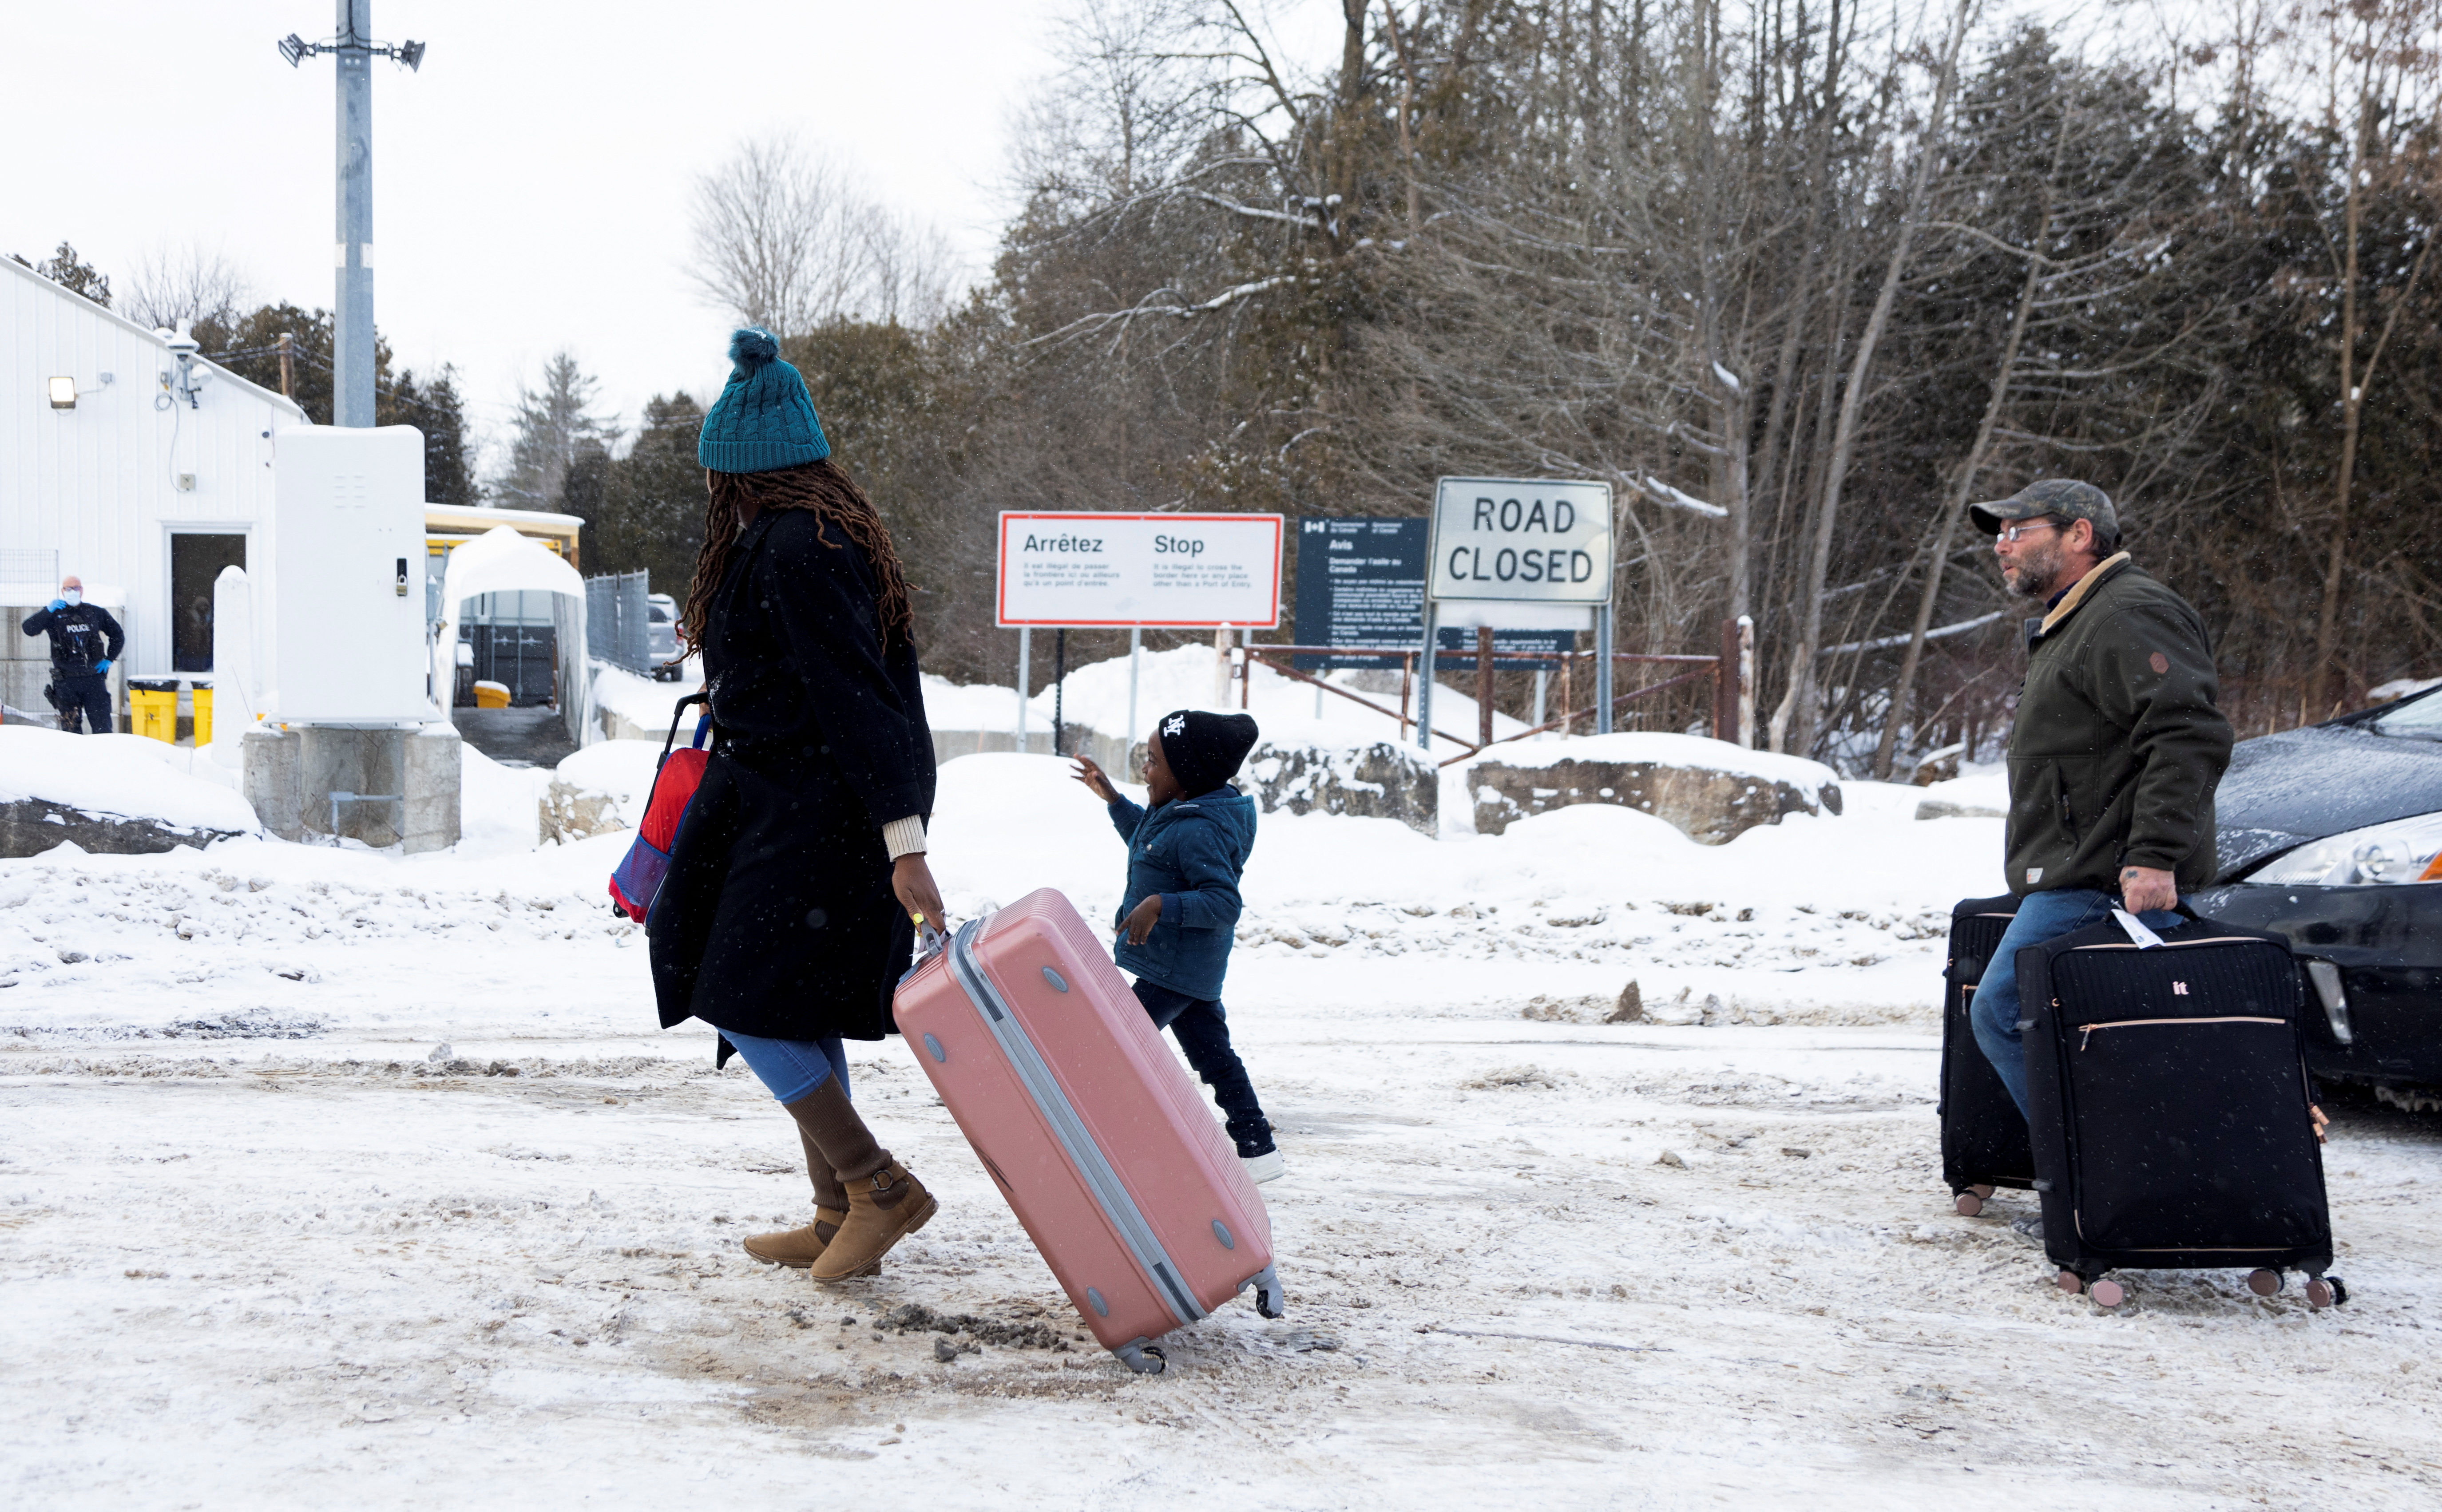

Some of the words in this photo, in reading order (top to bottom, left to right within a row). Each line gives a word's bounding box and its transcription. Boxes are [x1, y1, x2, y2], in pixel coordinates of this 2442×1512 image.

[1474, 497, 1575, 533] ROAD
[1024, 533, 1102, 552] Arrêtez
[1155, 535, 1204, 558] Stop
[1329, 539, 1353, 550] Avis
[1449, 546, 1593, 582] CLOSED
[66, 623, 91, 633] POLICE
[2172, 981, 2189, 995] it
